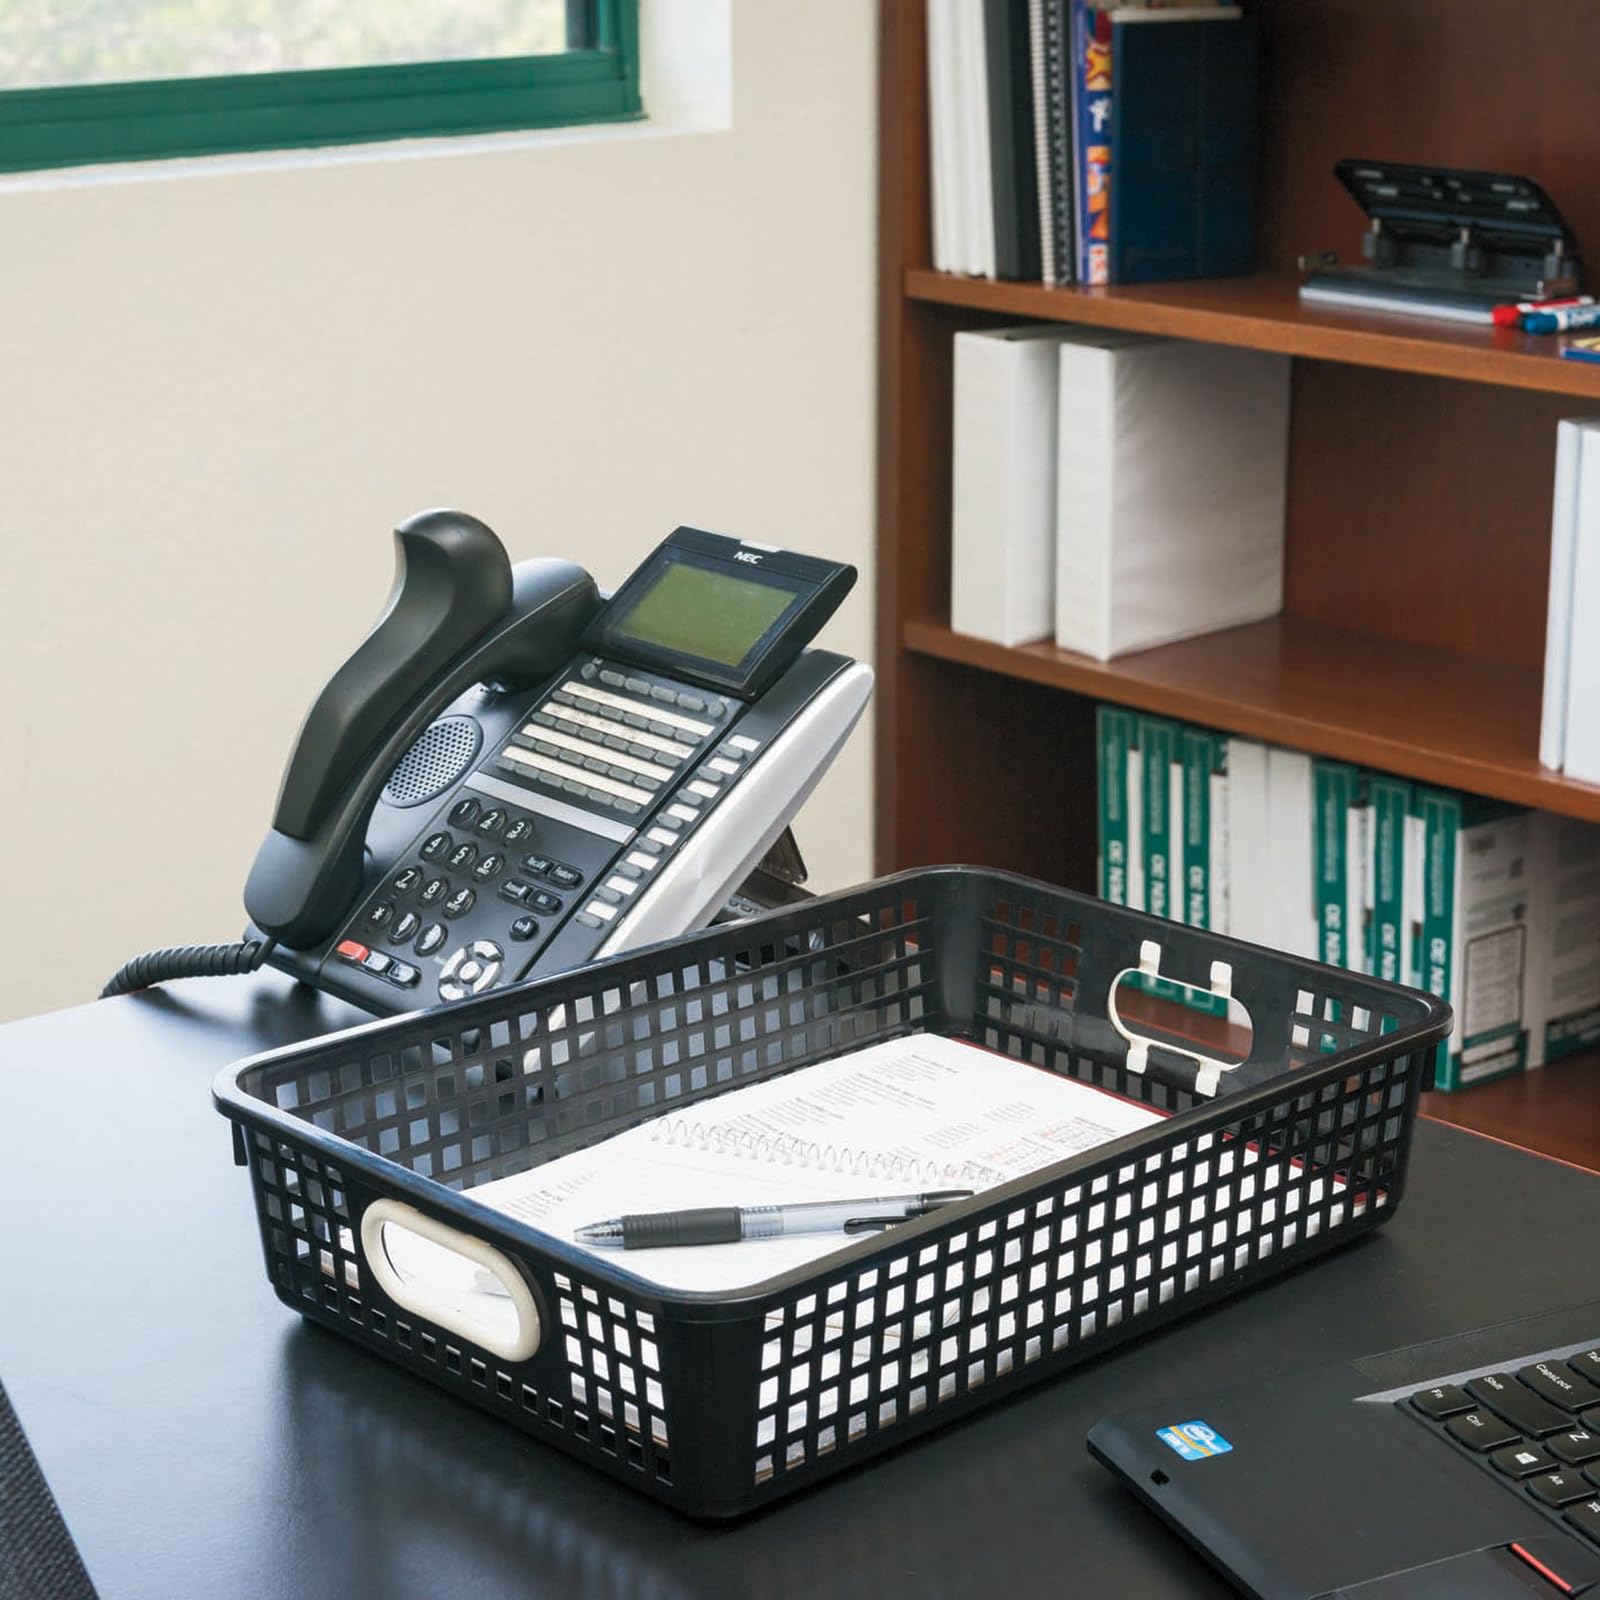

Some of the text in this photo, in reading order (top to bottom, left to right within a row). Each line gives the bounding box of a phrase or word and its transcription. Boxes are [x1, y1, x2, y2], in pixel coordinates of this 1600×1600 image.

[733, 551, 763, 565] NEC
[459, 802, 470, 814] 1
[487, 812, 498, 823] 2
[511, 822, 525, 834] 3
[430, 836, 442, 848] 4
[455, 846, 469, 859] 5
[482, 857, 496, 869] 6
[401, 870, 415, 882] 7
[427, 881, 440, 894] 8
[453, 888, 470, 905] 9
[1483, 1376, 1504, 1390] Shift
[1431, 1388, 1444, 1399] Fn
[1466, 1415, 1485, 1427] Ctrl
[1548, 1475, 1564, 1486] Alt
